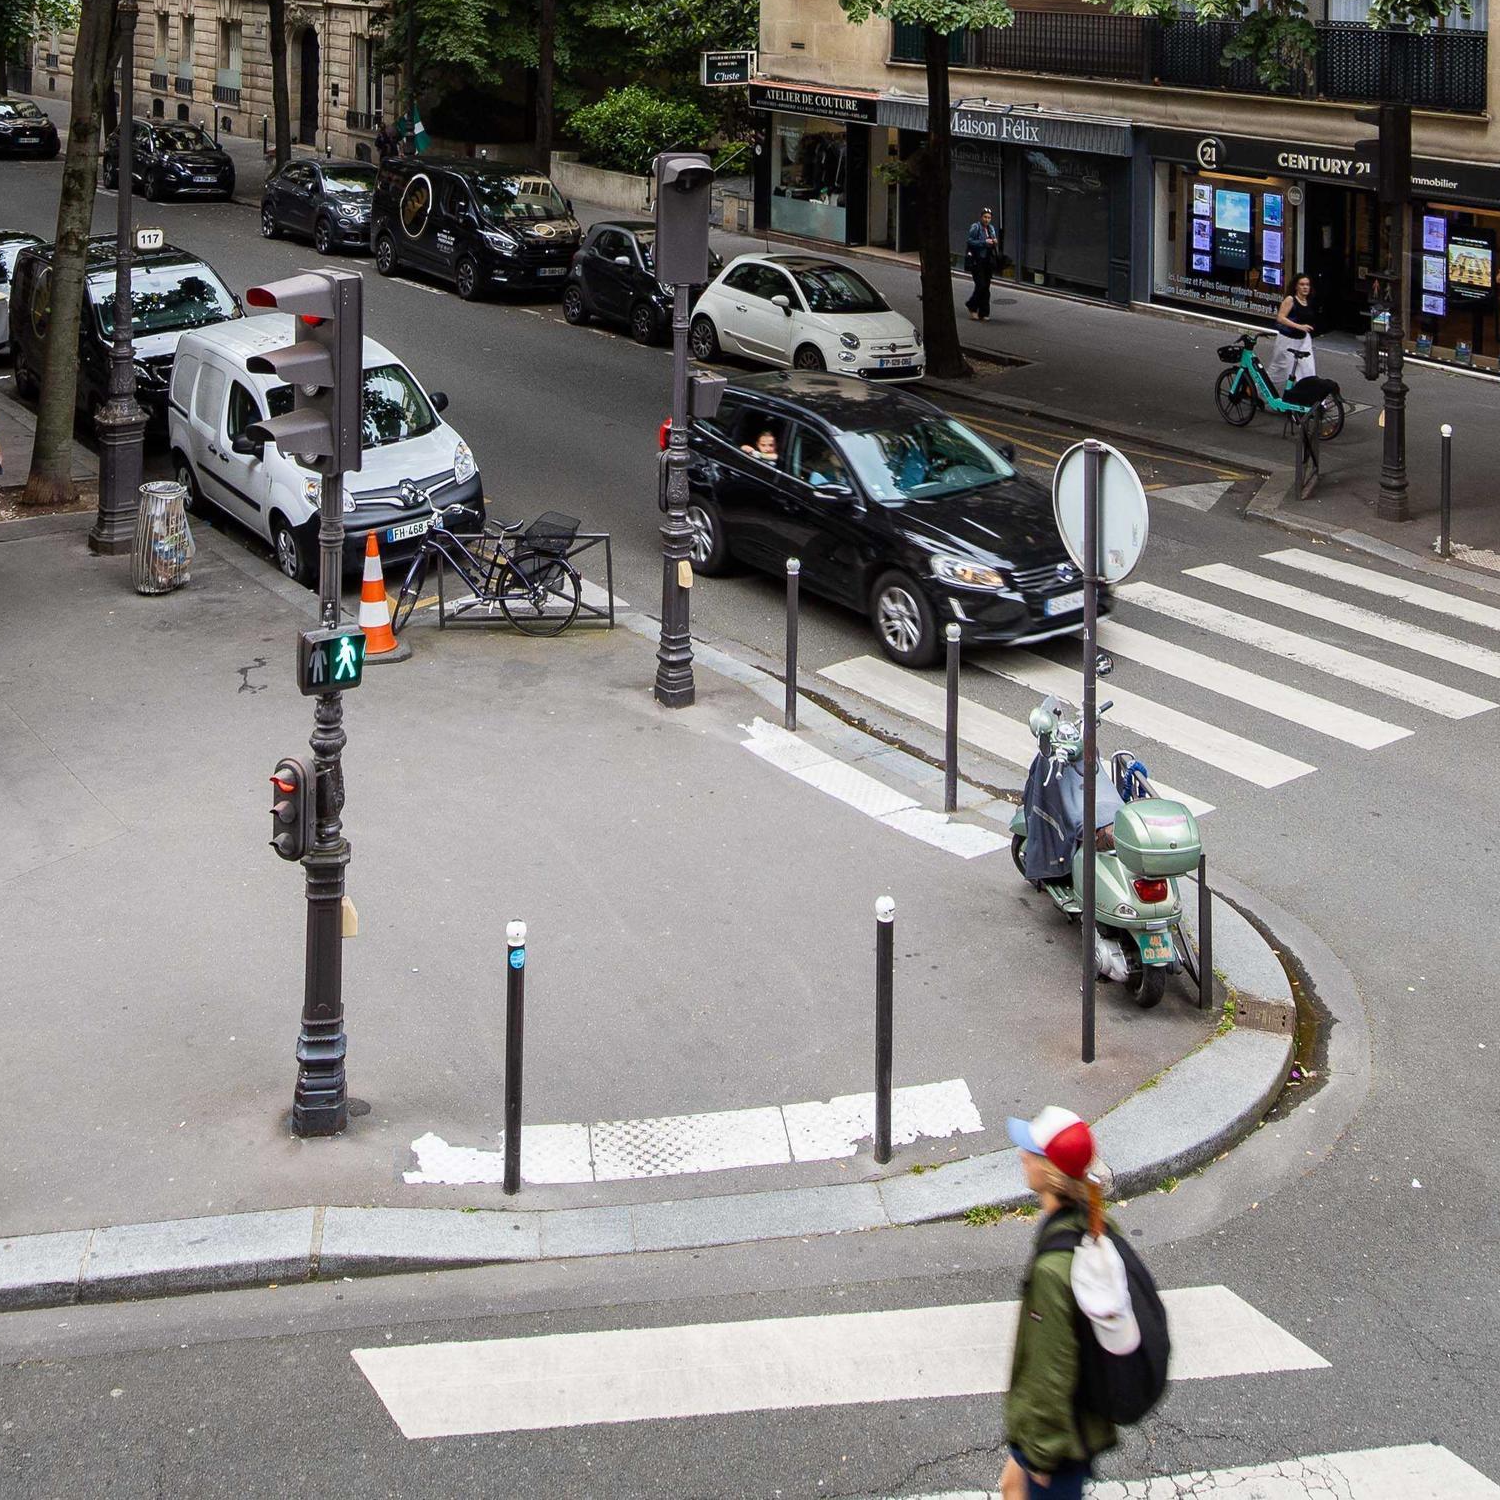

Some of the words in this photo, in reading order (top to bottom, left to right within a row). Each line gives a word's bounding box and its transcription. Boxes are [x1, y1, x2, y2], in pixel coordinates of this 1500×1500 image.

[765, 89, 801, 104] ATELIER
[802, 93, 814, 105] DE
[815, 95, 858, 111] COUTURE
[1001, 117, 1040, 142] Félix
[1277, 152, 1353, 175] CENTURY
[141, 234, 159, 244] 117
